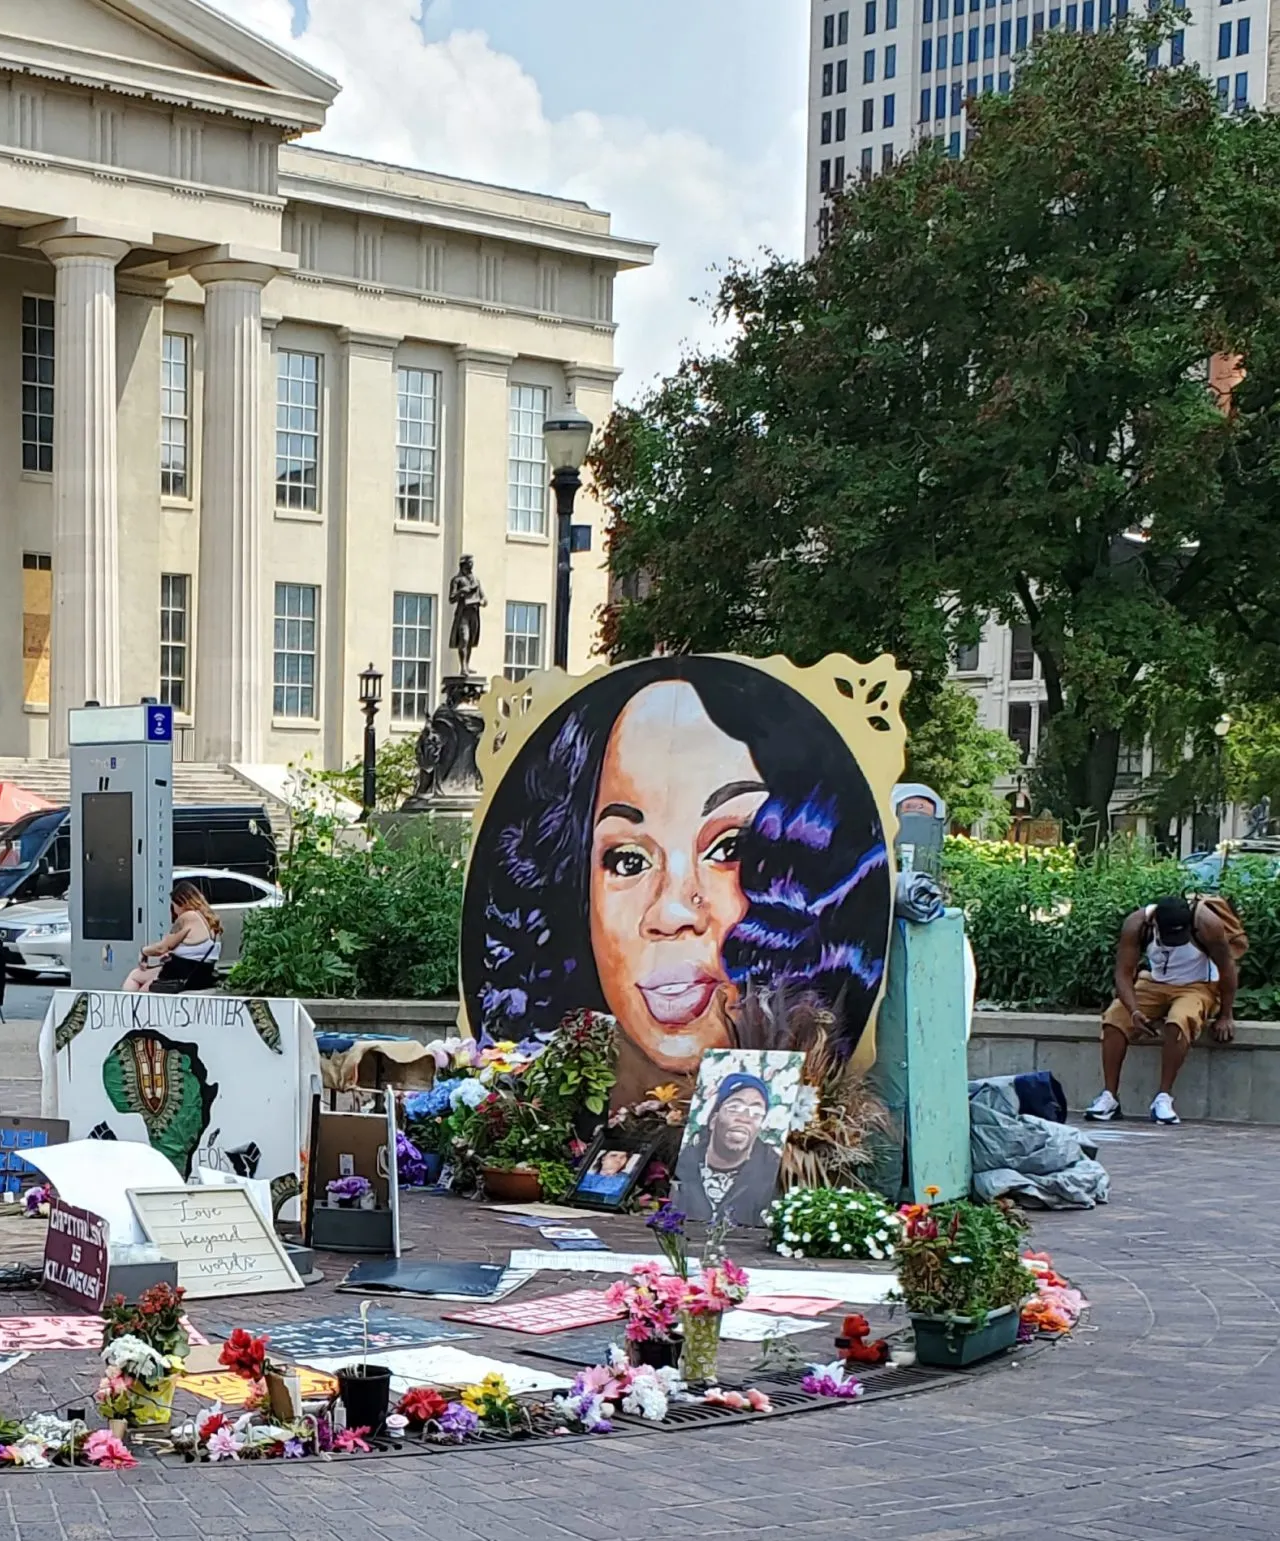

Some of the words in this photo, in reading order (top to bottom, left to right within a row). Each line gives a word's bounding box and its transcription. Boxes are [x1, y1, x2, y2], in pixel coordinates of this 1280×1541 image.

[89, 992, 142, 1030] BLACK
[173, 1199, 222, 1223] Love
[179, 1225, 247, 1254] beyond
[70, 1243, 82, 1264] IS
[199, 1252, 257, 1275] words
